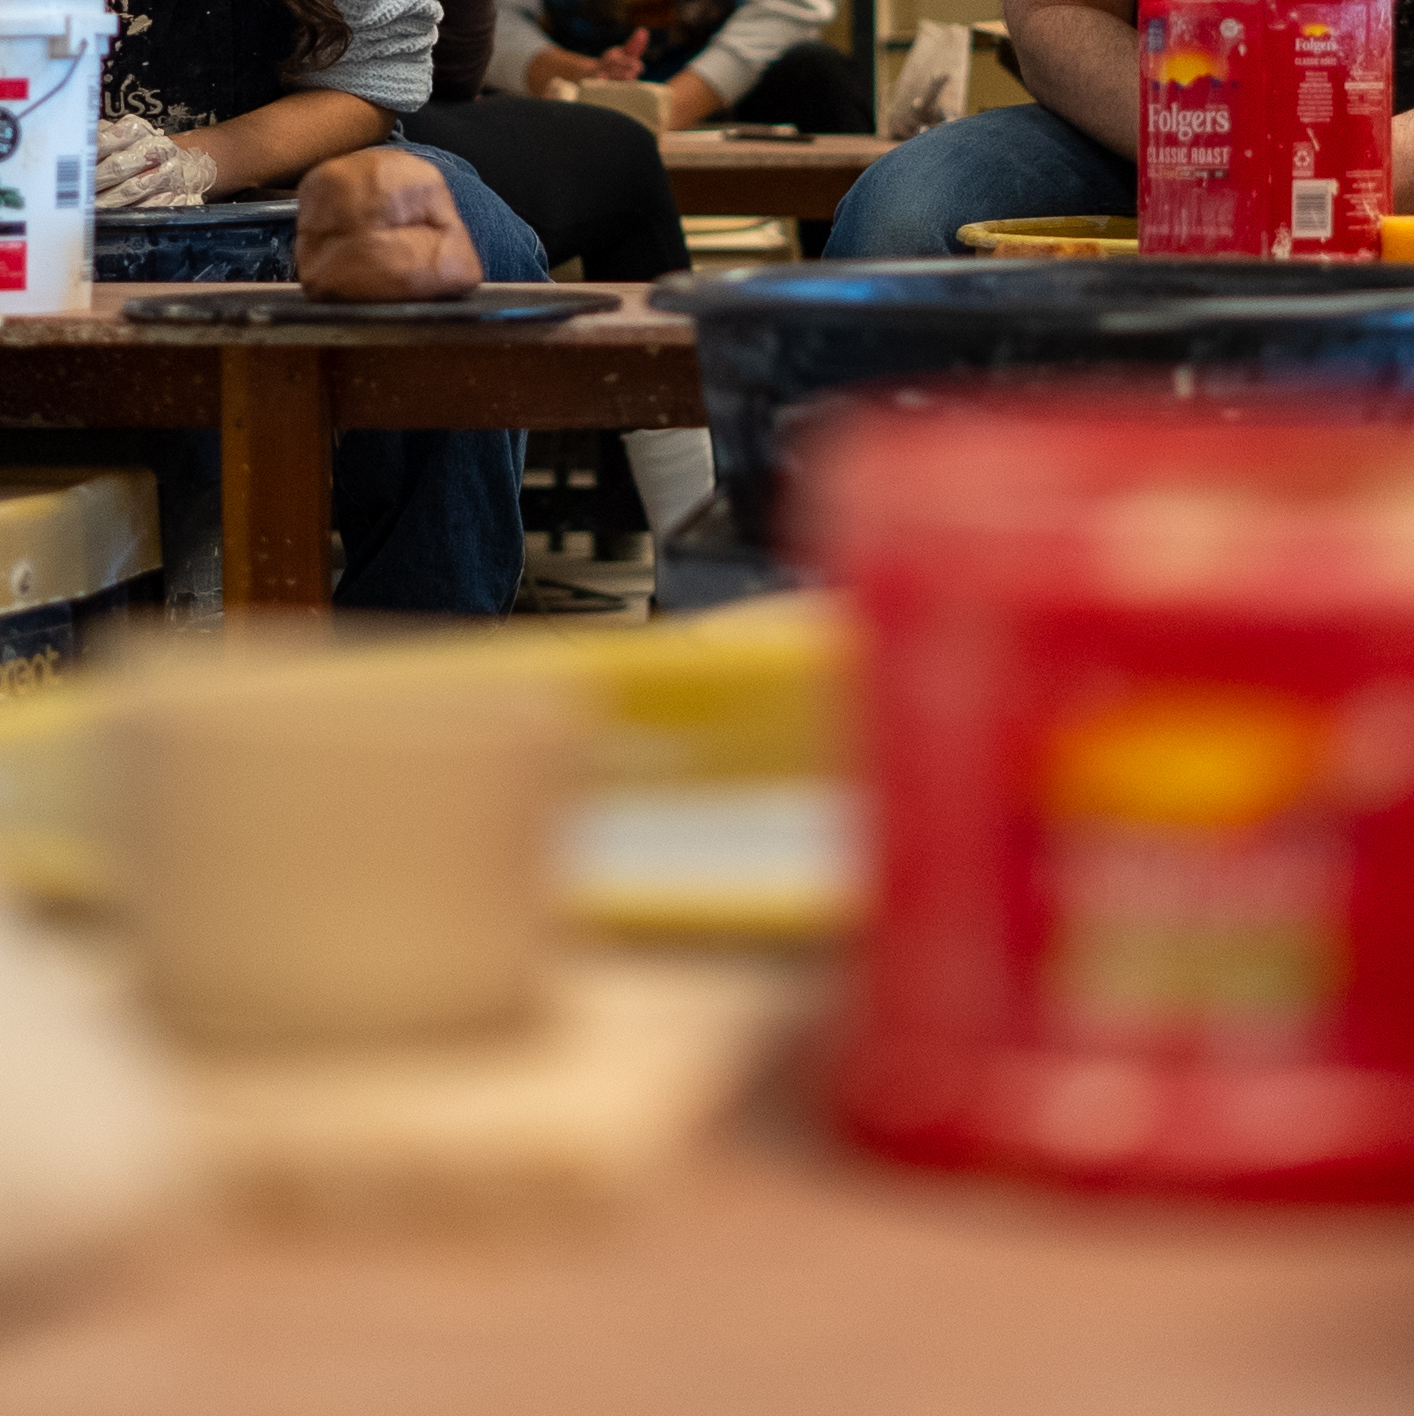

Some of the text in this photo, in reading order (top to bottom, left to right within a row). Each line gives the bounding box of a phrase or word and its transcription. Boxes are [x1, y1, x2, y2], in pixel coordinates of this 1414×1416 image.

[1148, 102, 1231, 141] Folgers
[1147, 146, 1230, 164] CLASSIC ROAST
